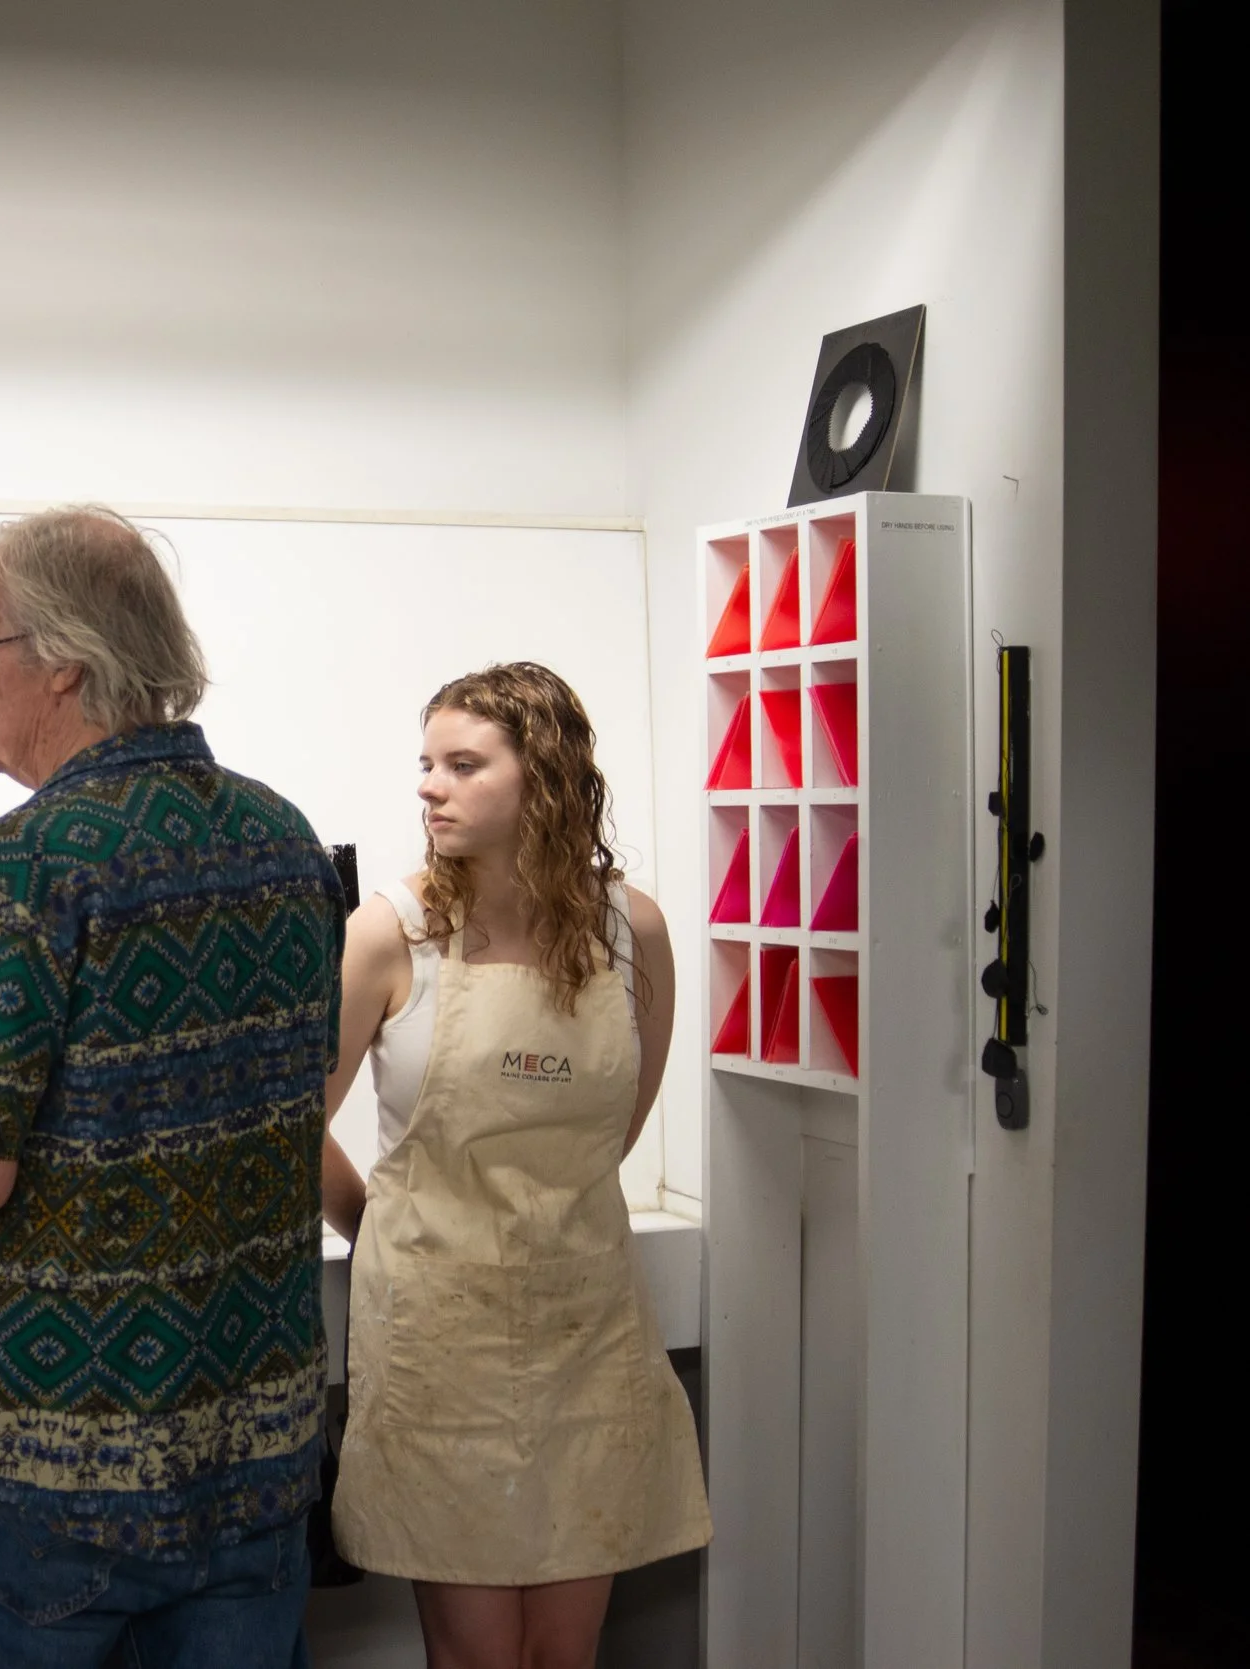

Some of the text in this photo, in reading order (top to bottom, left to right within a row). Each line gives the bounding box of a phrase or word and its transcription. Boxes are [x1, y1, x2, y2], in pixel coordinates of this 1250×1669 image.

[881, 521, 955, 532] DRY HANDS BEFORE USING
[502, 1051, 572, 1075] MECA
[500, 1071, 520, 1079] MAINE
[522, 1074, 550, 1082] COLLEGE
